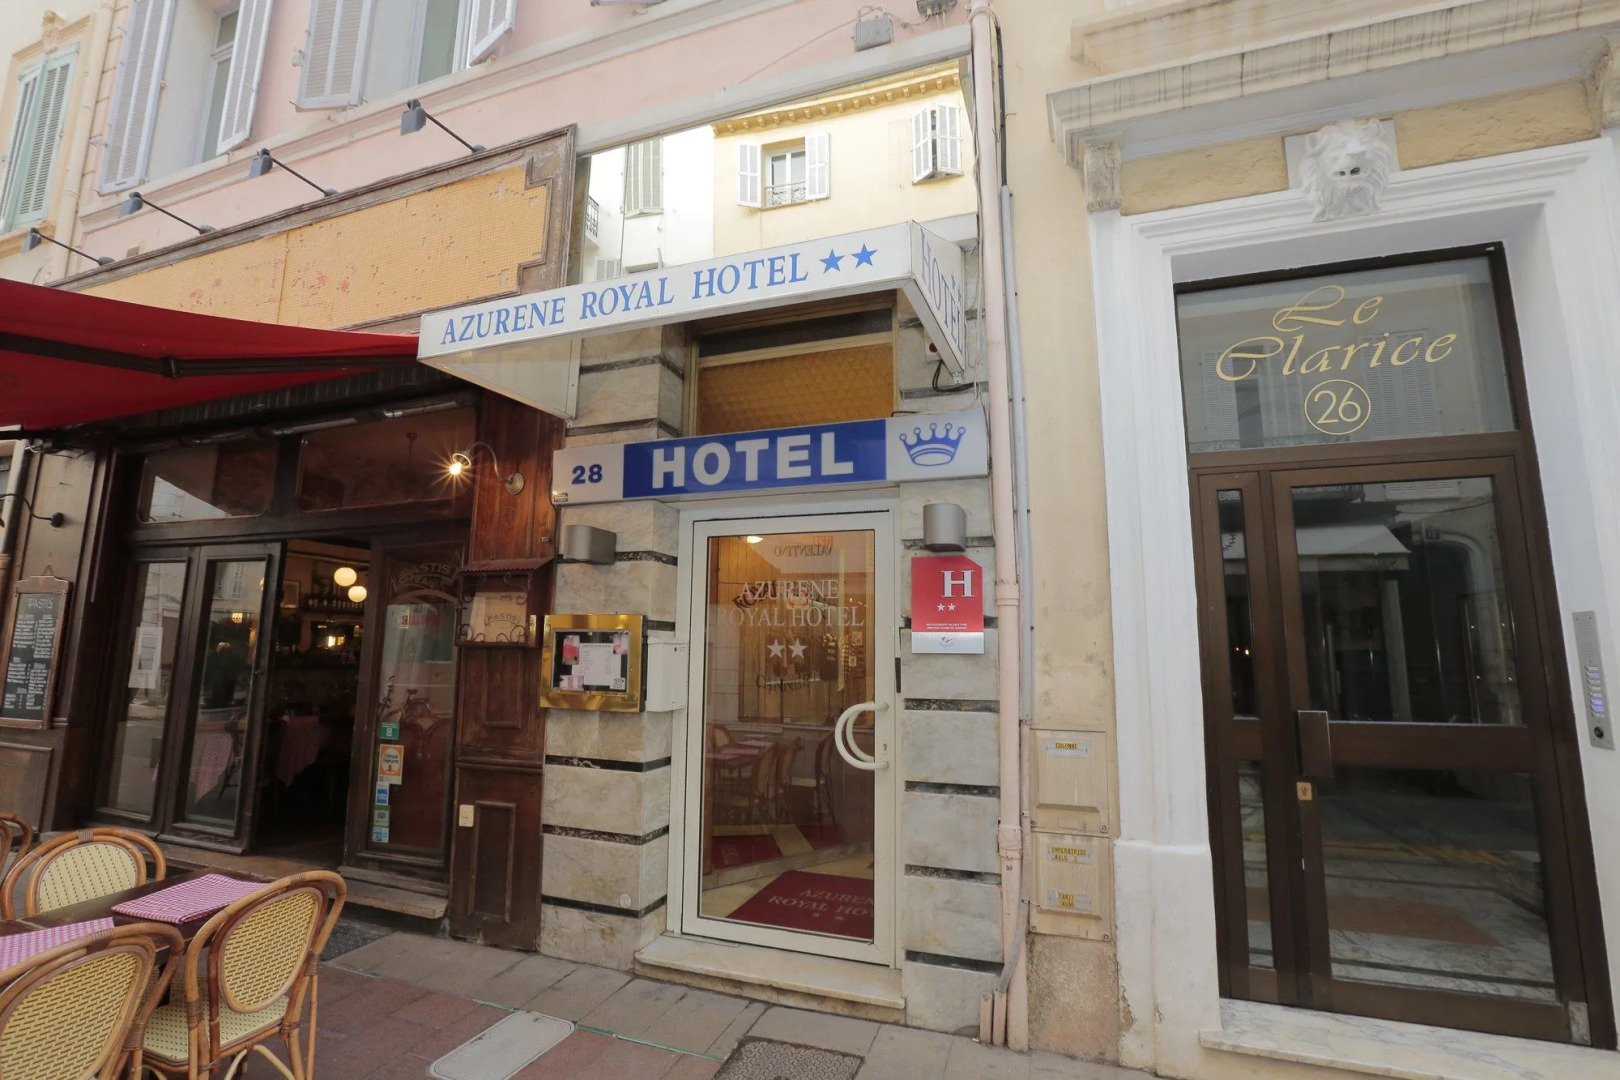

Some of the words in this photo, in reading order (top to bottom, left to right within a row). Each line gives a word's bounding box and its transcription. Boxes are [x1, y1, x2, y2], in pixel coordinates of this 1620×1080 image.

[440, 297, 566, 345] AZURENE
[579, 277, 675, 320] ROYAL
[691, 252, 809, 300] HOTEL
[1272, 285, 1383, 332] Le
[1216, 332, 1458, 381] Clarice
[1314, 387, 1362, 424] 26
[571, 463, 603, 485] 28
[652, 431, 854, 489] HOTEL
[739, 579, 840, 600] AZURENE
[940, 569, 975, 598] H
[487, 613, 517, 622] PASTIS
[717, 606, 786, 627] ROYAL
[791, 606, 865, 627] HOTEL
[768, 895, 828, 911] ROYAL
